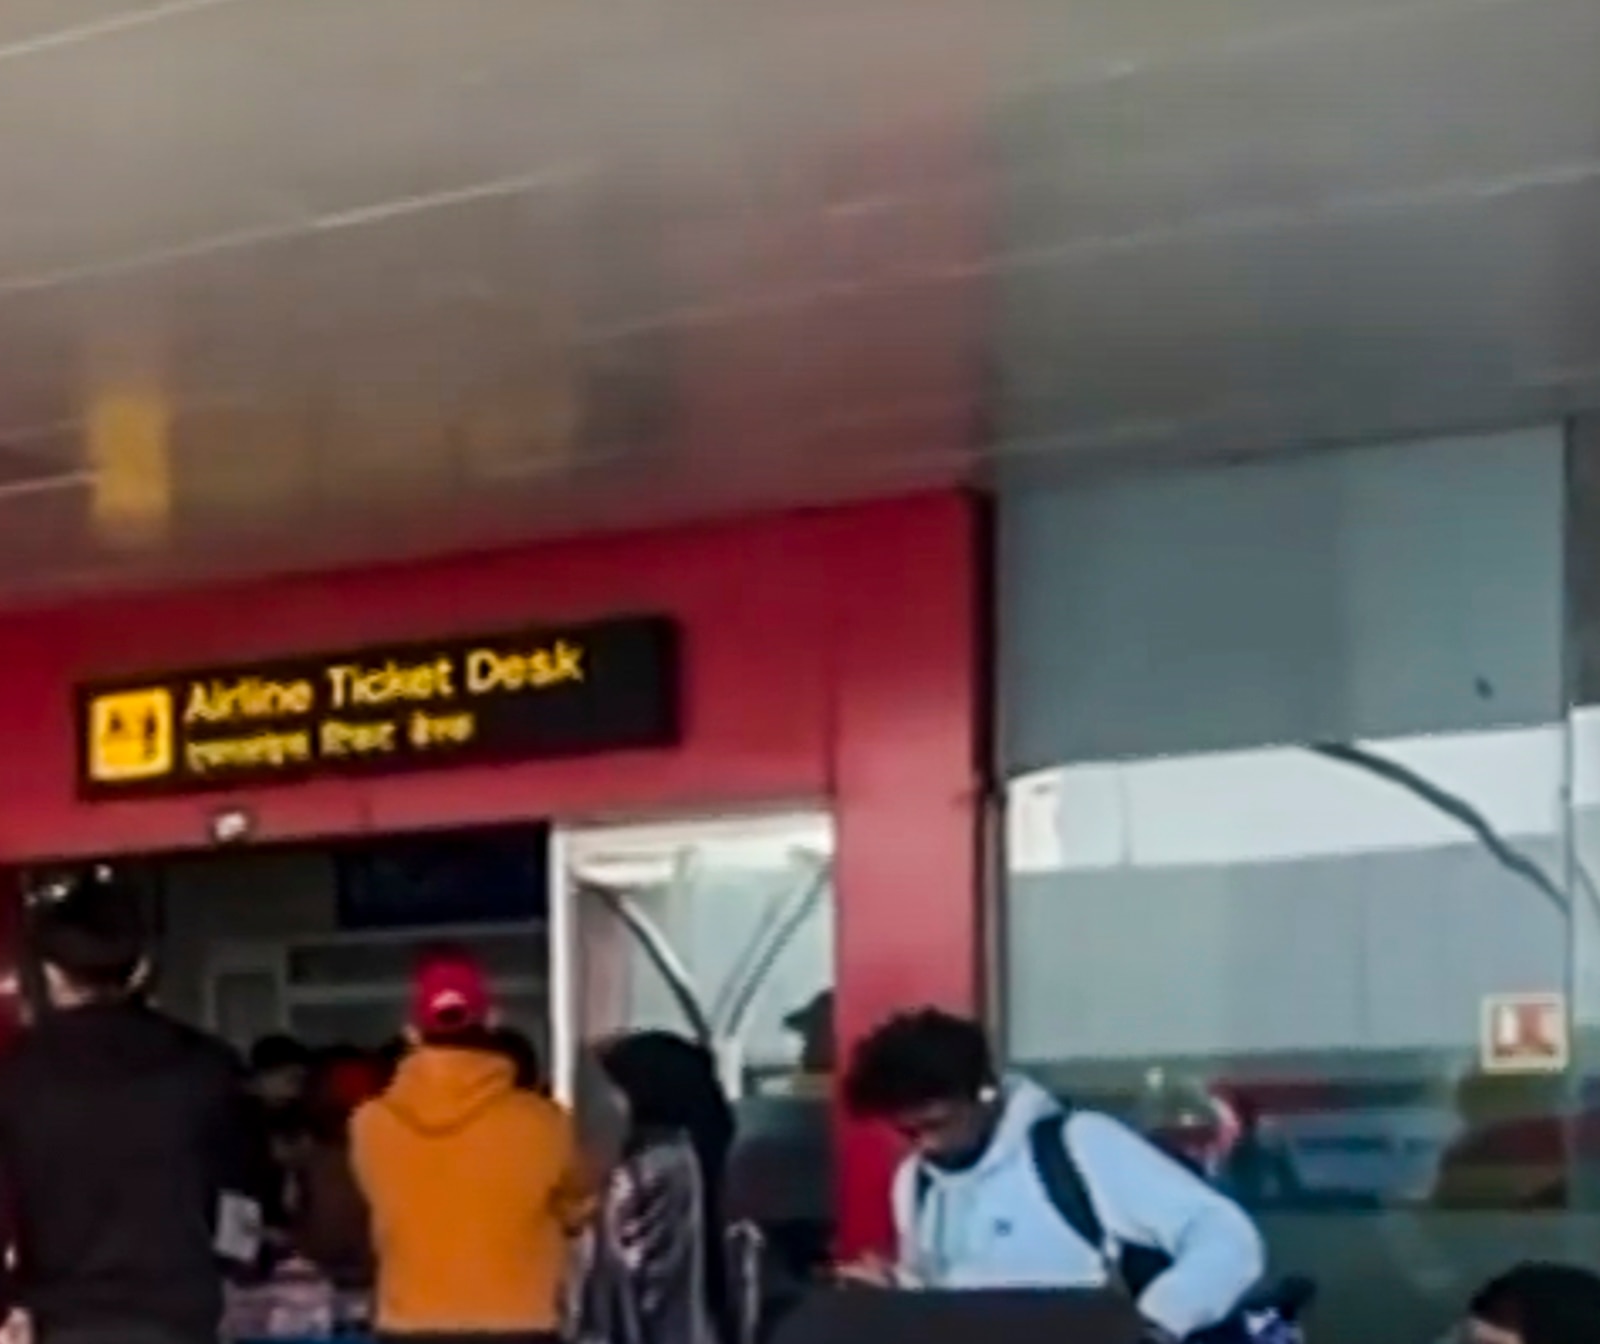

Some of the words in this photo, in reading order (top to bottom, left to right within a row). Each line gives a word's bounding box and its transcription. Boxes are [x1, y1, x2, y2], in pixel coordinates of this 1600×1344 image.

[184, 676, 314, 722] Airline
[327, 658, 453, 709] Ticket
[467, 640, 584, 694] Desk
